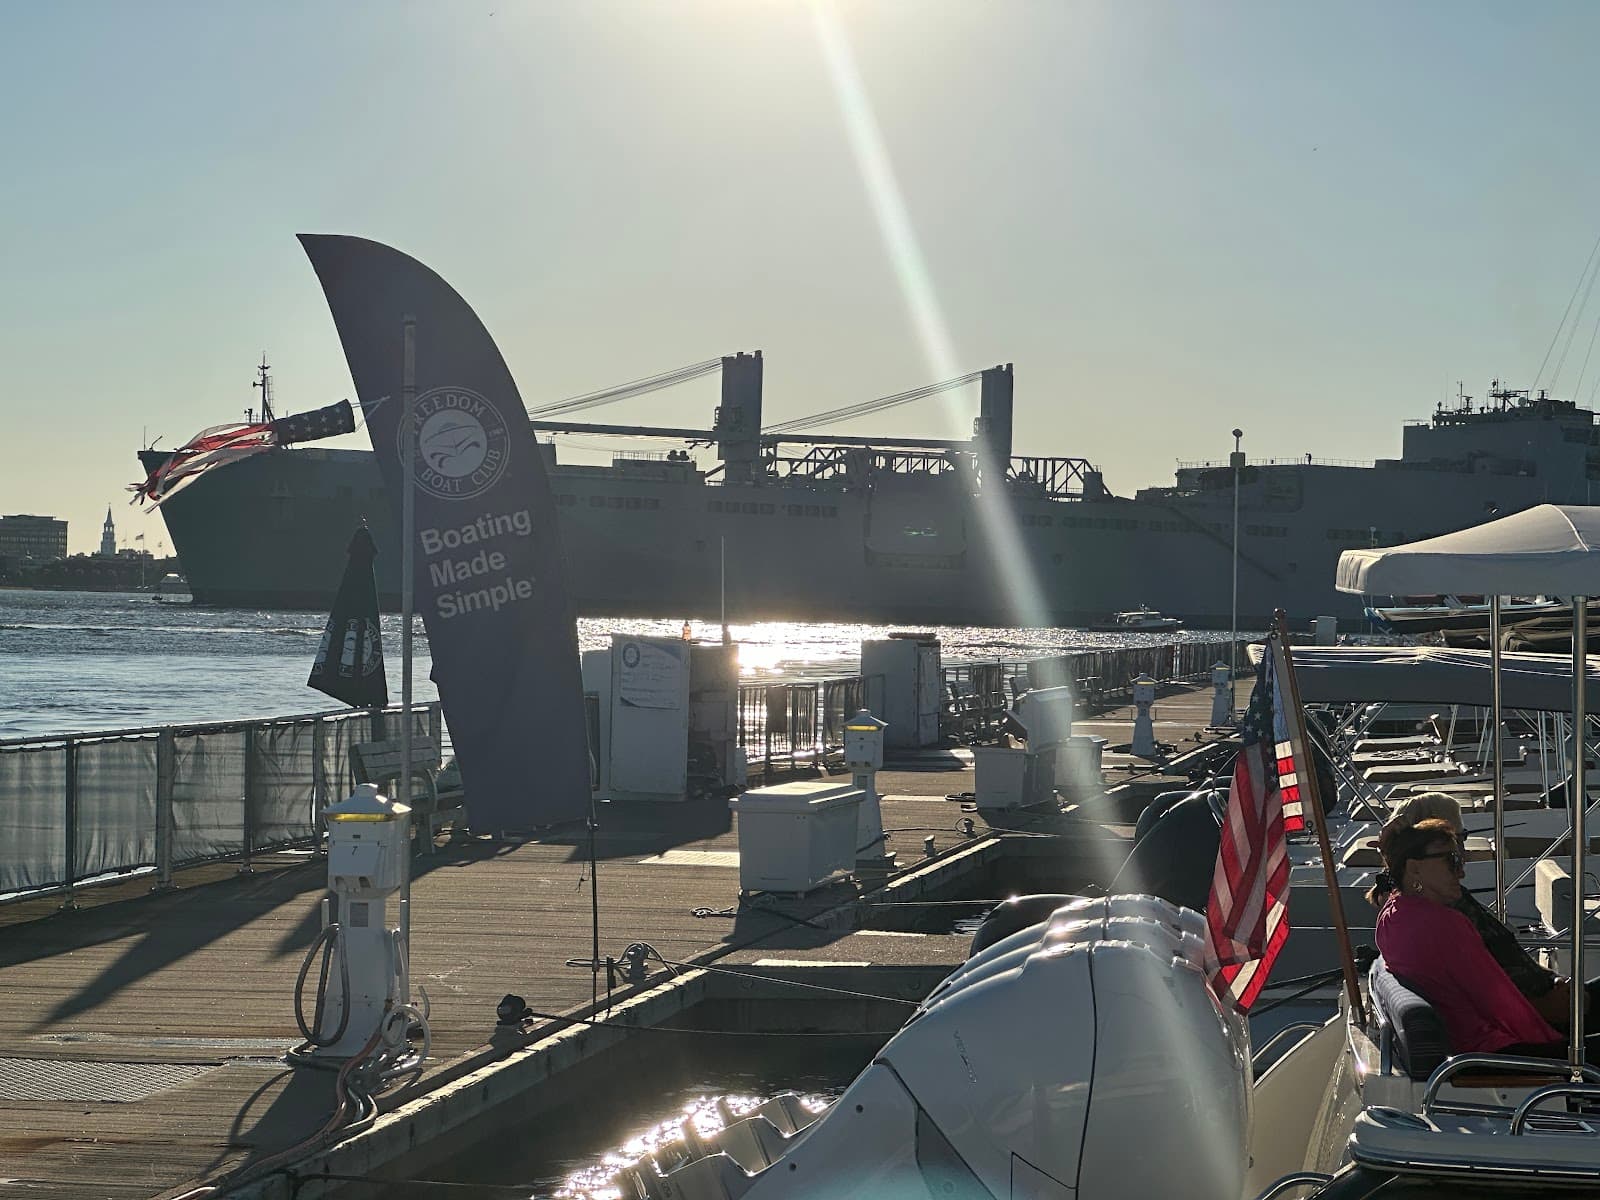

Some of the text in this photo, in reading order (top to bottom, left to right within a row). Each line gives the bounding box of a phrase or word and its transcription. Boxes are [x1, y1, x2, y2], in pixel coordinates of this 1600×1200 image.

[413, 394, 487, 435] REEDOM
[421, 448, 501, 492] BOAT CLUB
[420, 509, 532, 555] Boating
[429, 550, 505, 587] Made
[436, 577, 533, 619] Simple
